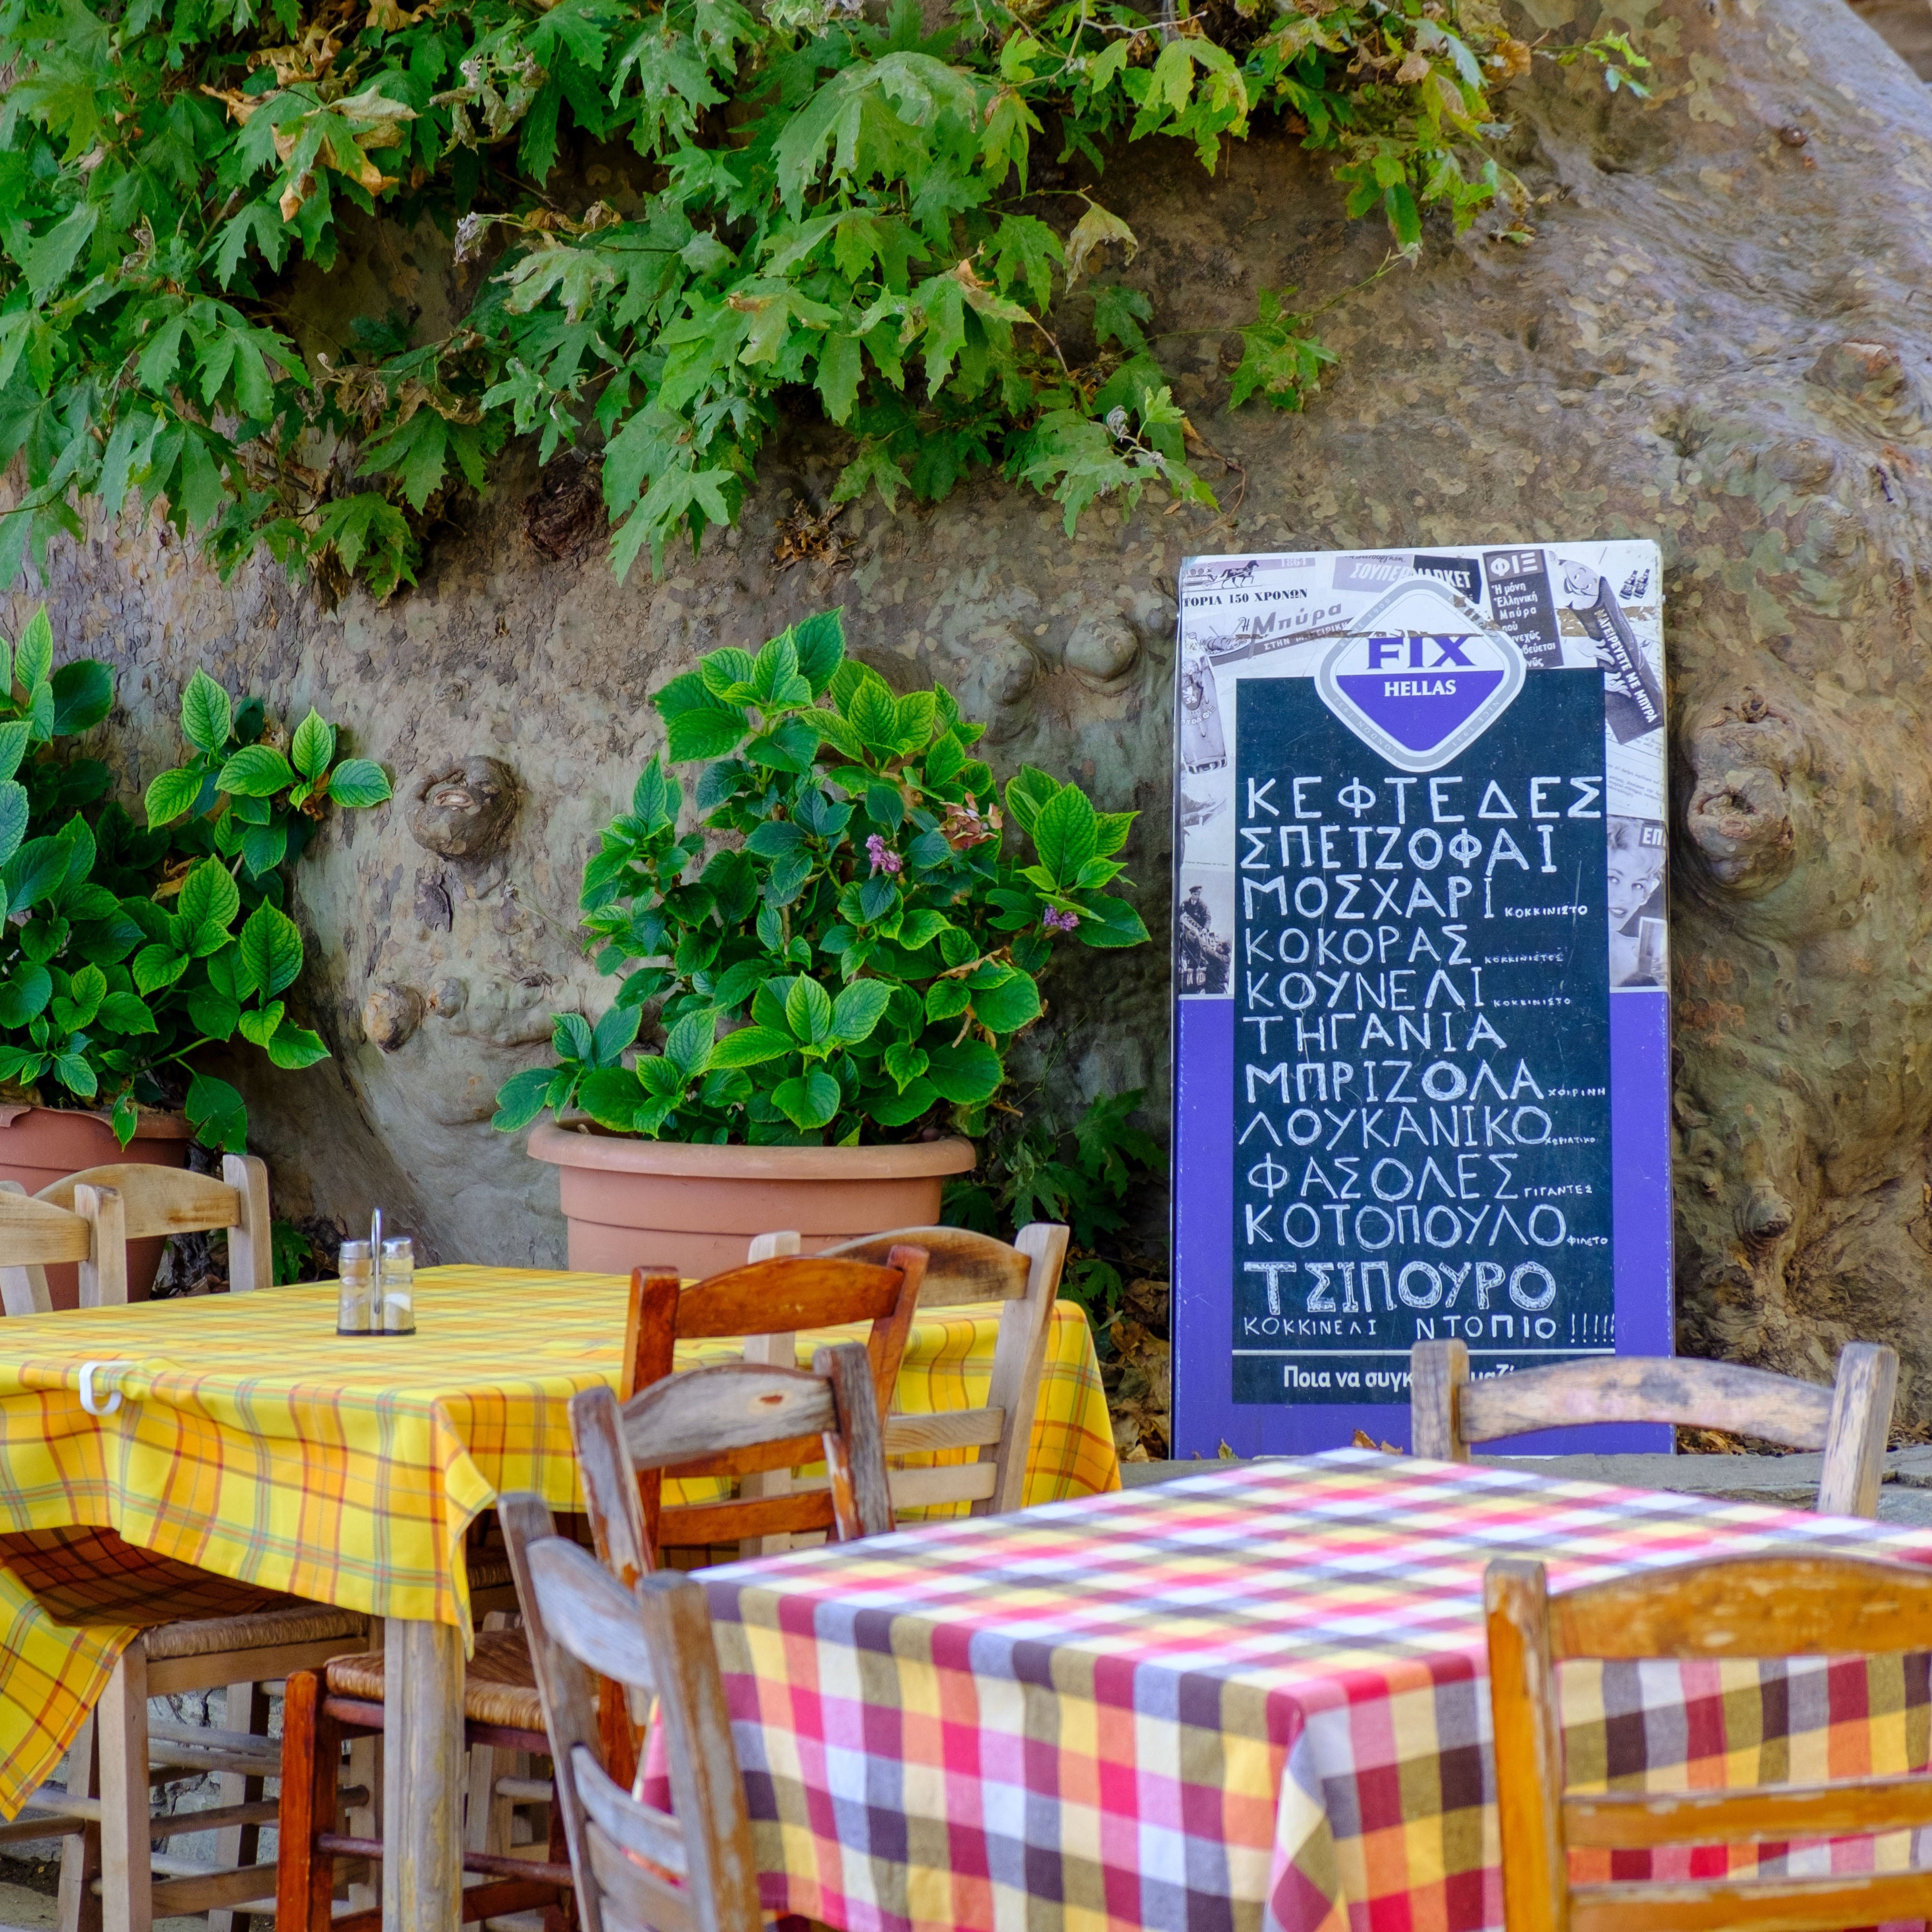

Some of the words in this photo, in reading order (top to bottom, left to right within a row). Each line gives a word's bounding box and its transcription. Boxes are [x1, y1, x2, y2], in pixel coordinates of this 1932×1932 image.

[1491, 552, 1538, 576] ΦΙΞ
[1229, 593, 1249, 604] 150
[1254, 588, 1308, 602] ΧΡΟΝΩΝ
[1500, 606, 1537, 620] Μπύρα
[1252, 603, 1342, 635] Μπύρα
[1263, 638, 1291, 651] ΣΤΗΝ
[1366, 635, 1477, 669] FIX
[1384, 679, 1456, 697] HELLAS
[1625, 672, 1642, 689] ΜΕ
[1358, 721, 1397, 755] LONDON
[1247, 776, 1604, 824] ΚΕΦΤΕΔΕΣ
[1240, 825, 1557, 876] ΣΠΕΤΖΟΦΑΙ
[1243, 874, 1494, 920] ΜΟΣΧΑΡΙ
[1505, 905, 1588, 918] ΚΟΚΚΙΝΙΣΤΟ
[1245, 924, 1472, 965] ΚΟΚΟΡΑΣ
[1247, 966, 1485, 1010] ΚΟΥΝΕΛΙ
[1243, 1013, 1507, 1054] ΤΗΓΑΝΙΑ
[1246, 1059, 1544, 1103] ΜΠΡΙΖΟΛΑ
[1239, 1106, 1552, 1150] ΛΟΥΚΑΝΙΚΟ
[1248, 1153, 1518, 1201] ΦΑΣΟΛΕΣ
[1246, 1204, 1566, 1251] ΚΟΤΟΠΟΥΛΟ
[1244, 1261, 1556, 1315] ΤΣΙΠΟΥΡΟ
[1244, 1317, 1377, 1335] ΚΟΚΚΙΝΕΛΙ
[1416, 1315, 1556, 1339] ΝΤΟΠΙΟ
[1284, 1365, 1331, 1387] Ποια
[1335, 1371, 1361, 1387] να
